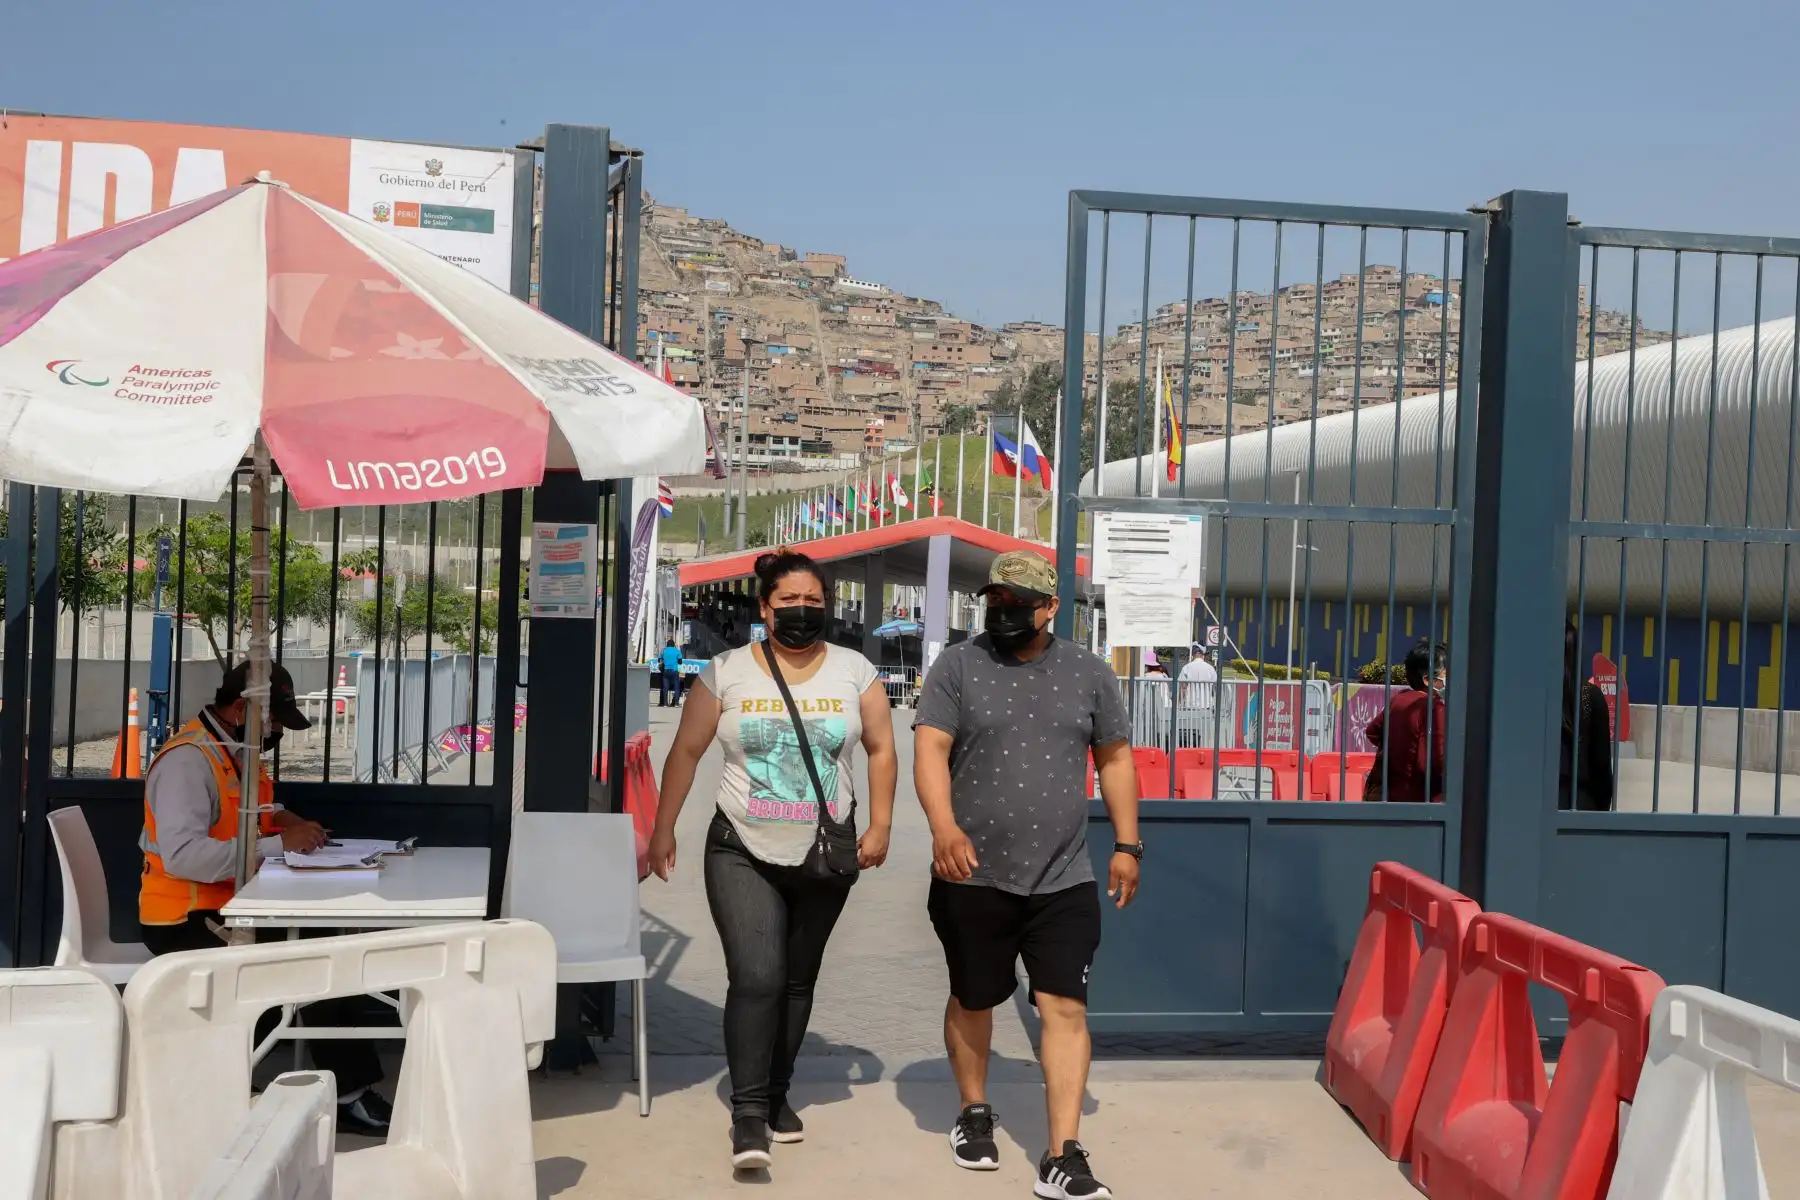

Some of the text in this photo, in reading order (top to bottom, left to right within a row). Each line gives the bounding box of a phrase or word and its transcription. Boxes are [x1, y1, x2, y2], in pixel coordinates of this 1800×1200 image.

[379, 173, 487, 193] Gobierno del Perú
[0, 139, 228, 264] IDA
[423, 212, 453, 221] Ministerio
[438, 255, 481, 264] NTENARIO
[128, 364, 213, 378] Americas
[120, 376, 221, 393] Paralympic
[531, 373, 637, 397] SPORTS
[114, 388, 214, 405] Committee
[633, 572, 643, 606] LIMA
[740, 698, 845, 713] REBLDE
[747, 799, 838, 820] BROOKLN
